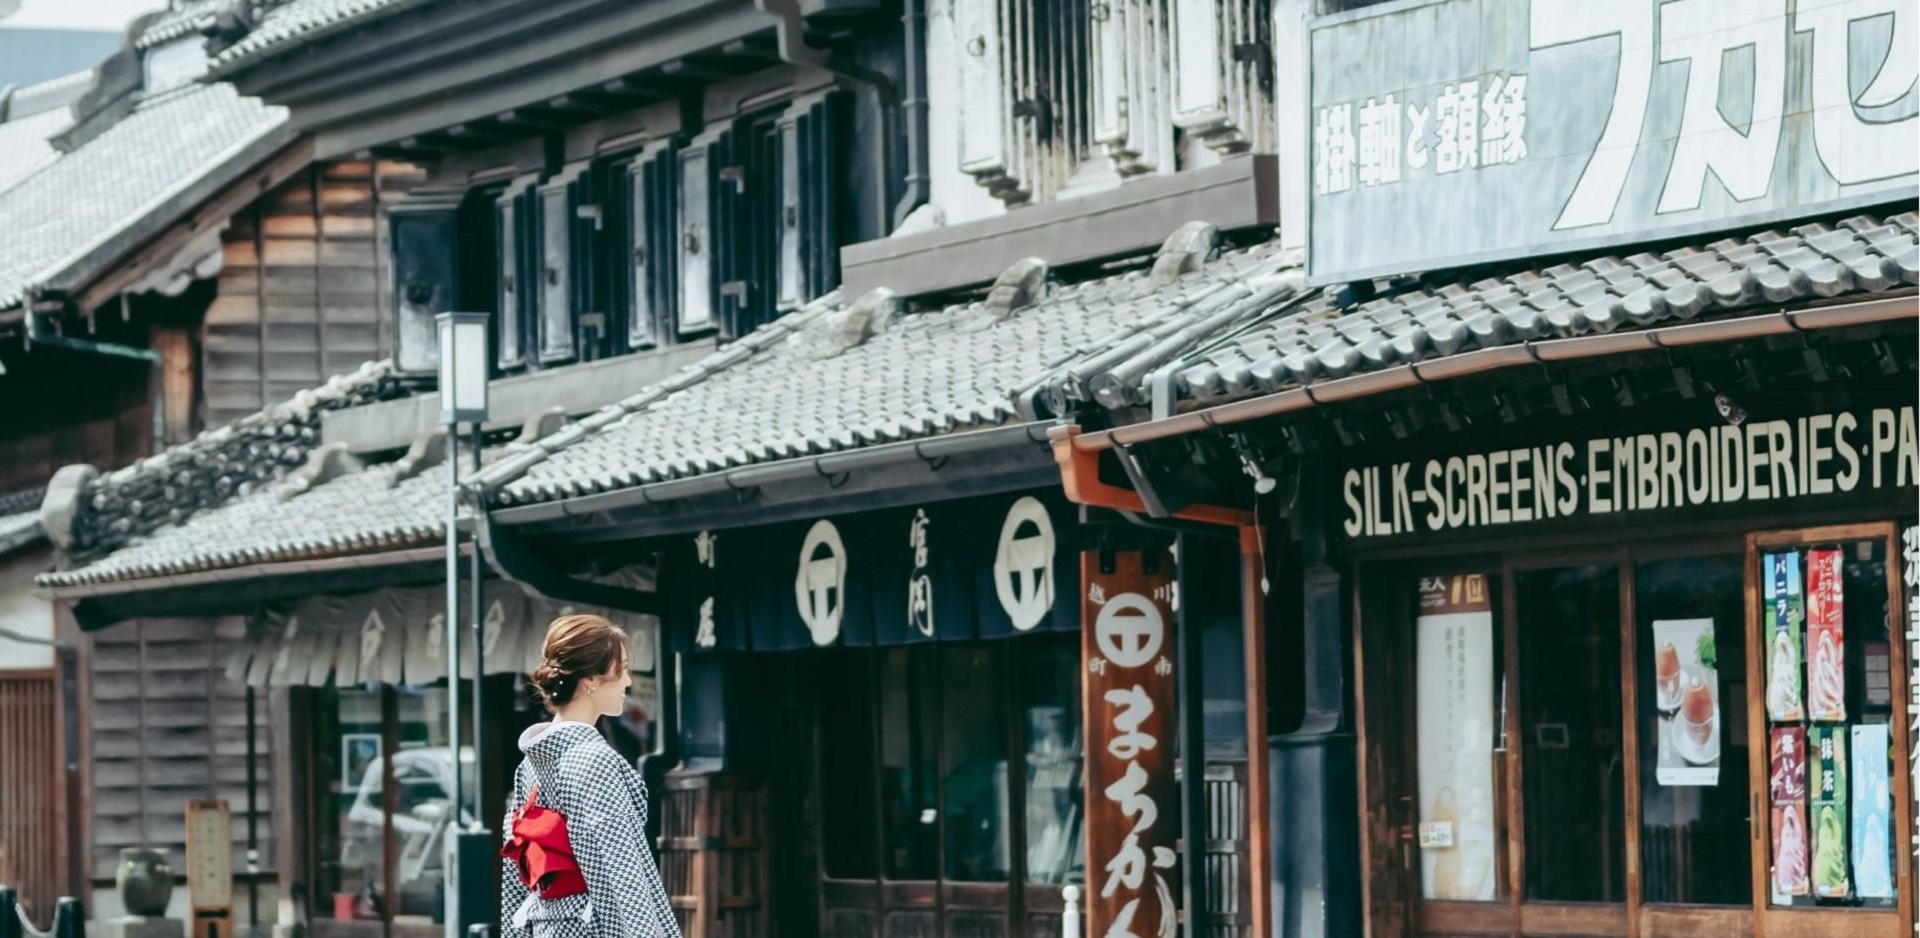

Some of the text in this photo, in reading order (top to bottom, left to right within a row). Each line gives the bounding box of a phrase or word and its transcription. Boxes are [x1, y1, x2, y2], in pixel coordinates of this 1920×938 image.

[1316, 73, 1528, 196] 掛軸と額縁
[1344, 441, 1578, 538] SILK-SCREENS
[1588, 411, 1860, 514] EMBROIDERIES
